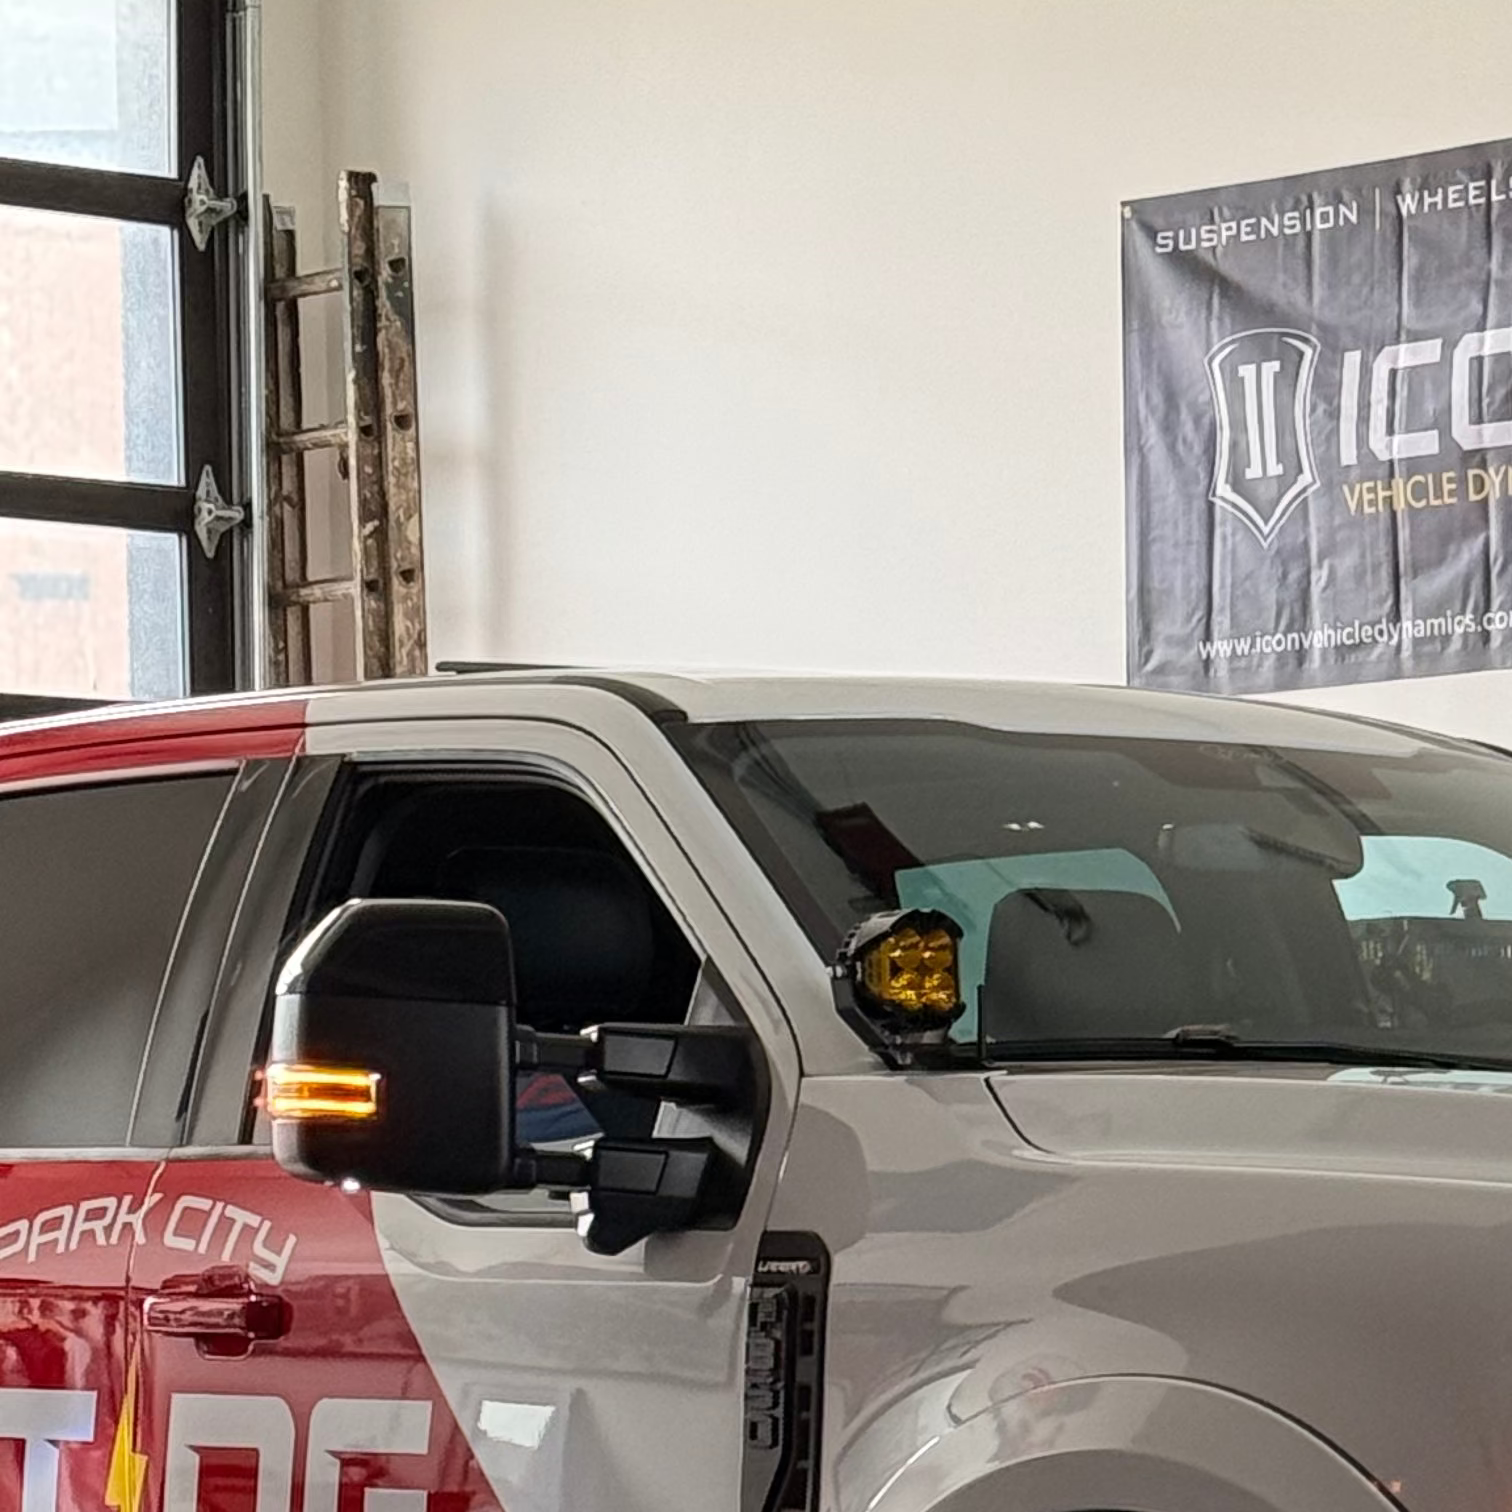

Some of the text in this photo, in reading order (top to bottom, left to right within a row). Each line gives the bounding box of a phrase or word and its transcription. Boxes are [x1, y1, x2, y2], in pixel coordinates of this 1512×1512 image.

[1155, 200, 1358, 254] SUSPENSION
[1342, 470, 1458, 515] VEHICLE
[163, 1194, 297, 1286] CITY
